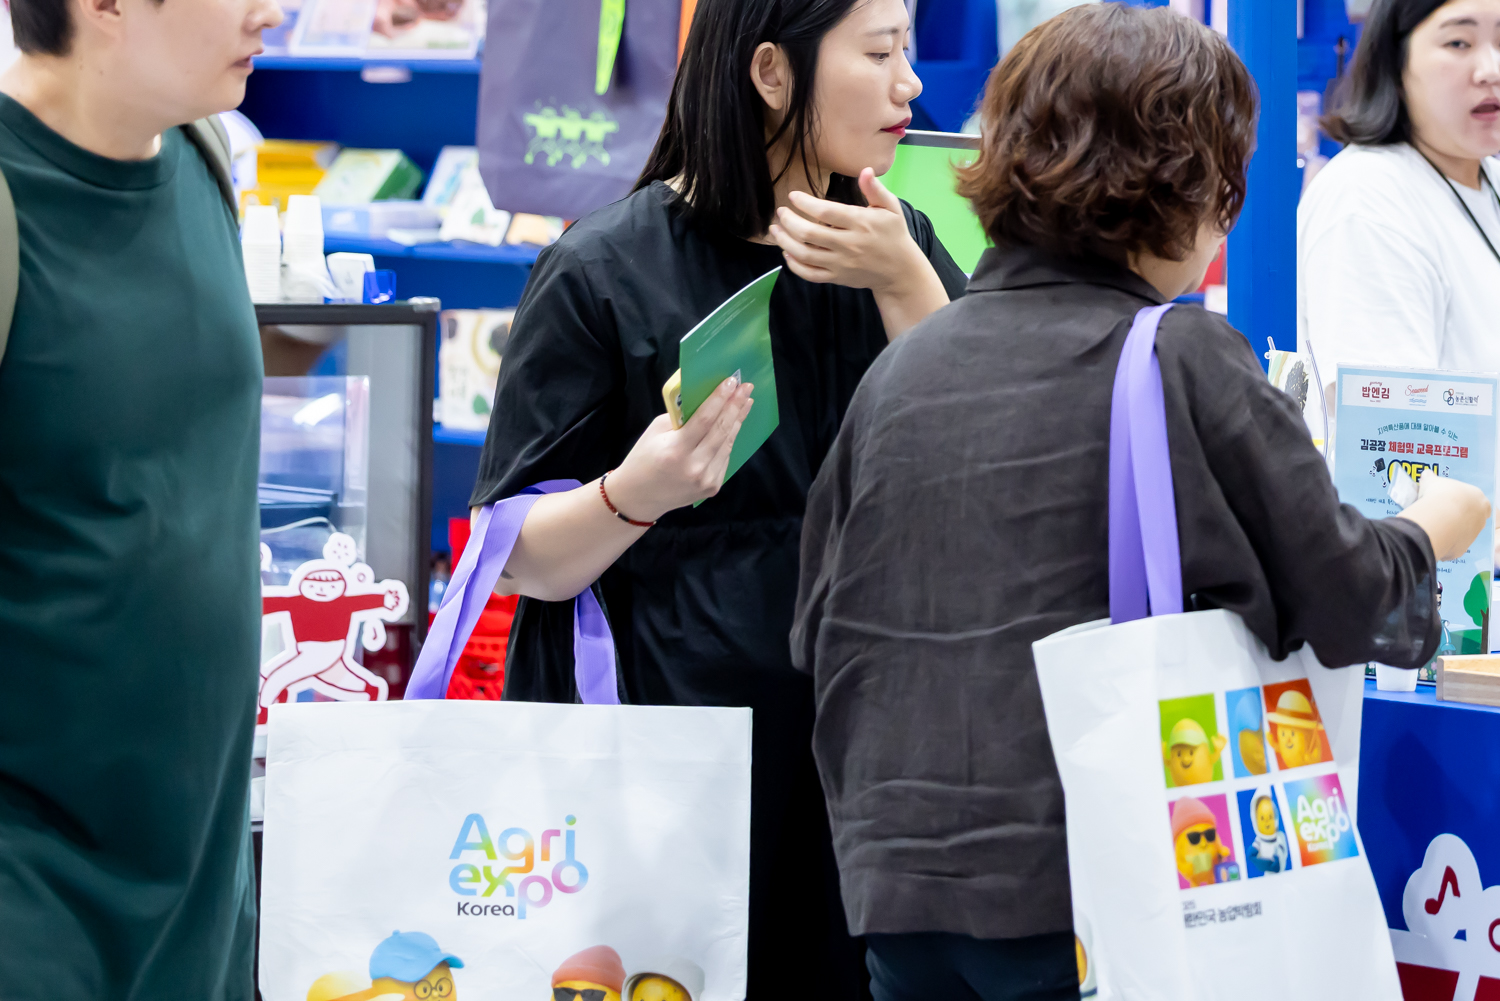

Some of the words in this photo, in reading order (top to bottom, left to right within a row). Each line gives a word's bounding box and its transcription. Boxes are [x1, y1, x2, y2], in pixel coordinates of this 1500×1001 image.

[1362, 386, 1390, 400] 밥엔김
[1440, 428, 1447, 436] 수
[1447, 430, 1459, 442] 있는
[1360, 438, 1387, 452] 김공장
[1387, 441, 1414, 454] 체험및
[1416, 443, 1469, 458] 교육프로그램
[1296, 787, 1343, 824] Agri
[449, 813, 577, 874] Agri
[449, 859, 589, 920] expo
[456, 901, 516, 917] Korea
